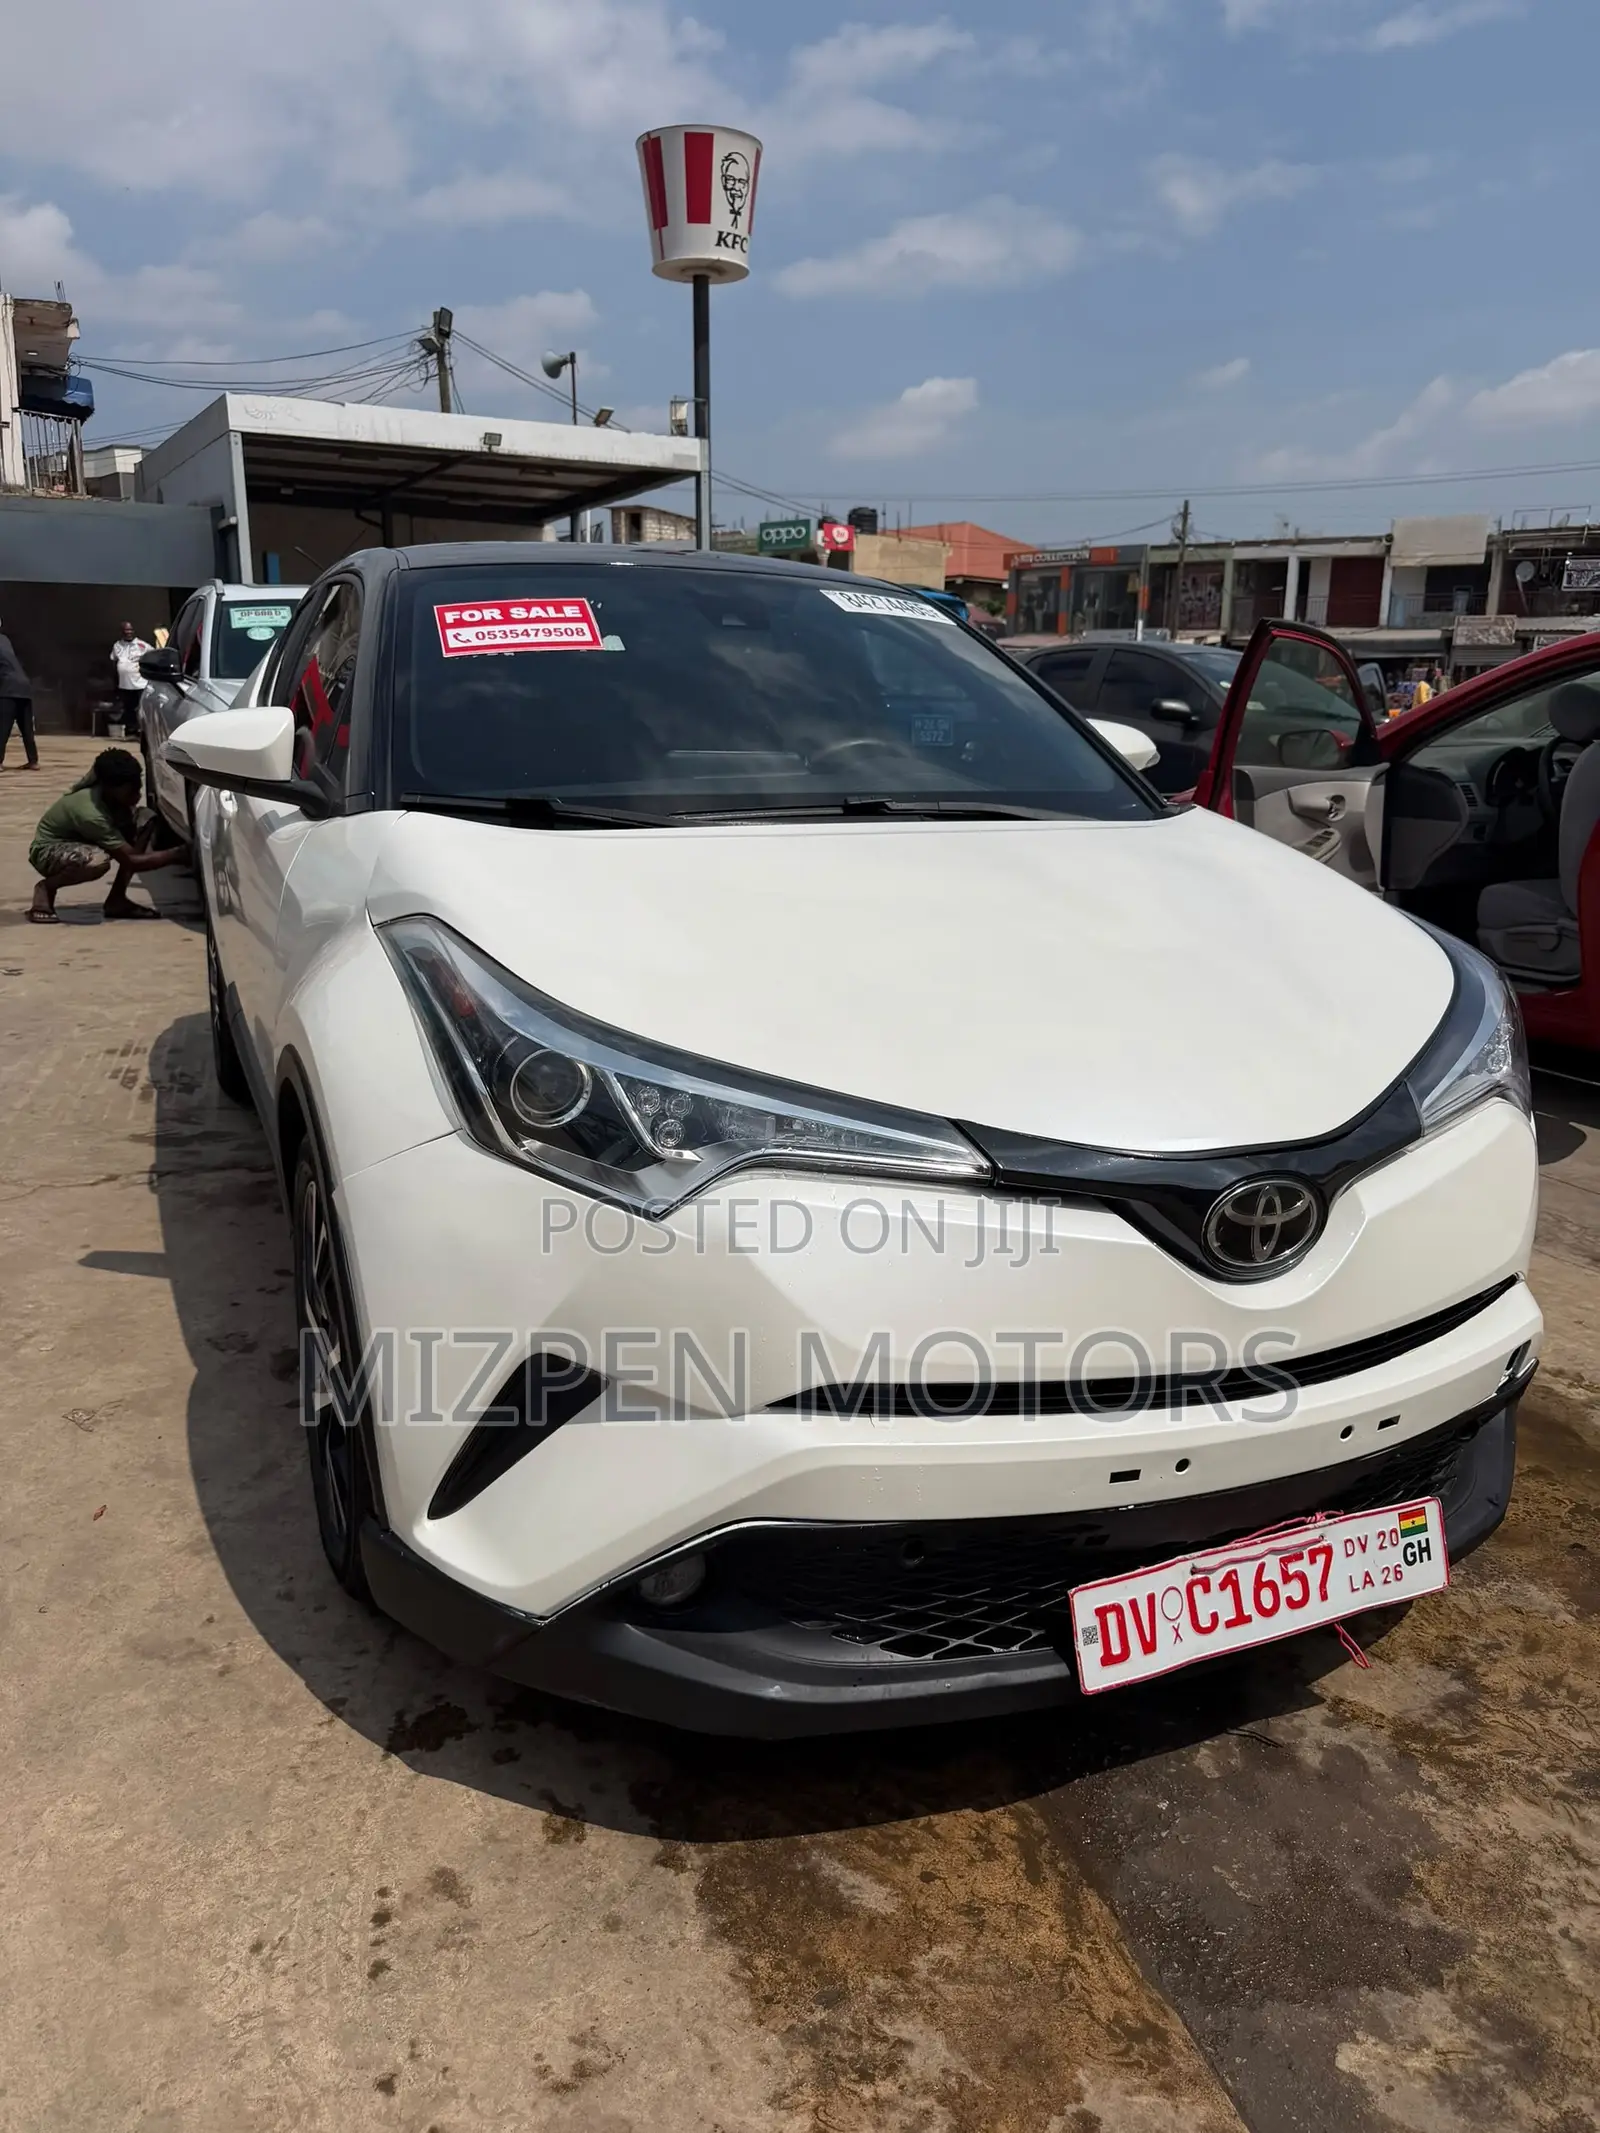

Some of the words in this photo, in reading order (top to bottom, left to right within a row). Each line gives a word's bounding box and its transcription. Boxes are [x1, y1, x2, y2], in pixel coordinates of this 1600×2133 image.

[715, 231, 748, 253] KFC
[444, 608, 503, 624] FOR
[509, 606, 583, 619] SALE
[475, 627, 586, 641] 0535479508
[1344, 1535, 1369, 1558] DV
[1377, 1527, 1400, 1551] 20
[1402, 1538, 1432, 1568] GH
[1348, 1573, 1375, 1593] LA
[1381, 1563, 1404, 1586] 26
[1094, 1592, 1158, 1668] DV
[1185, 1545, 1334, 1637] C1657
